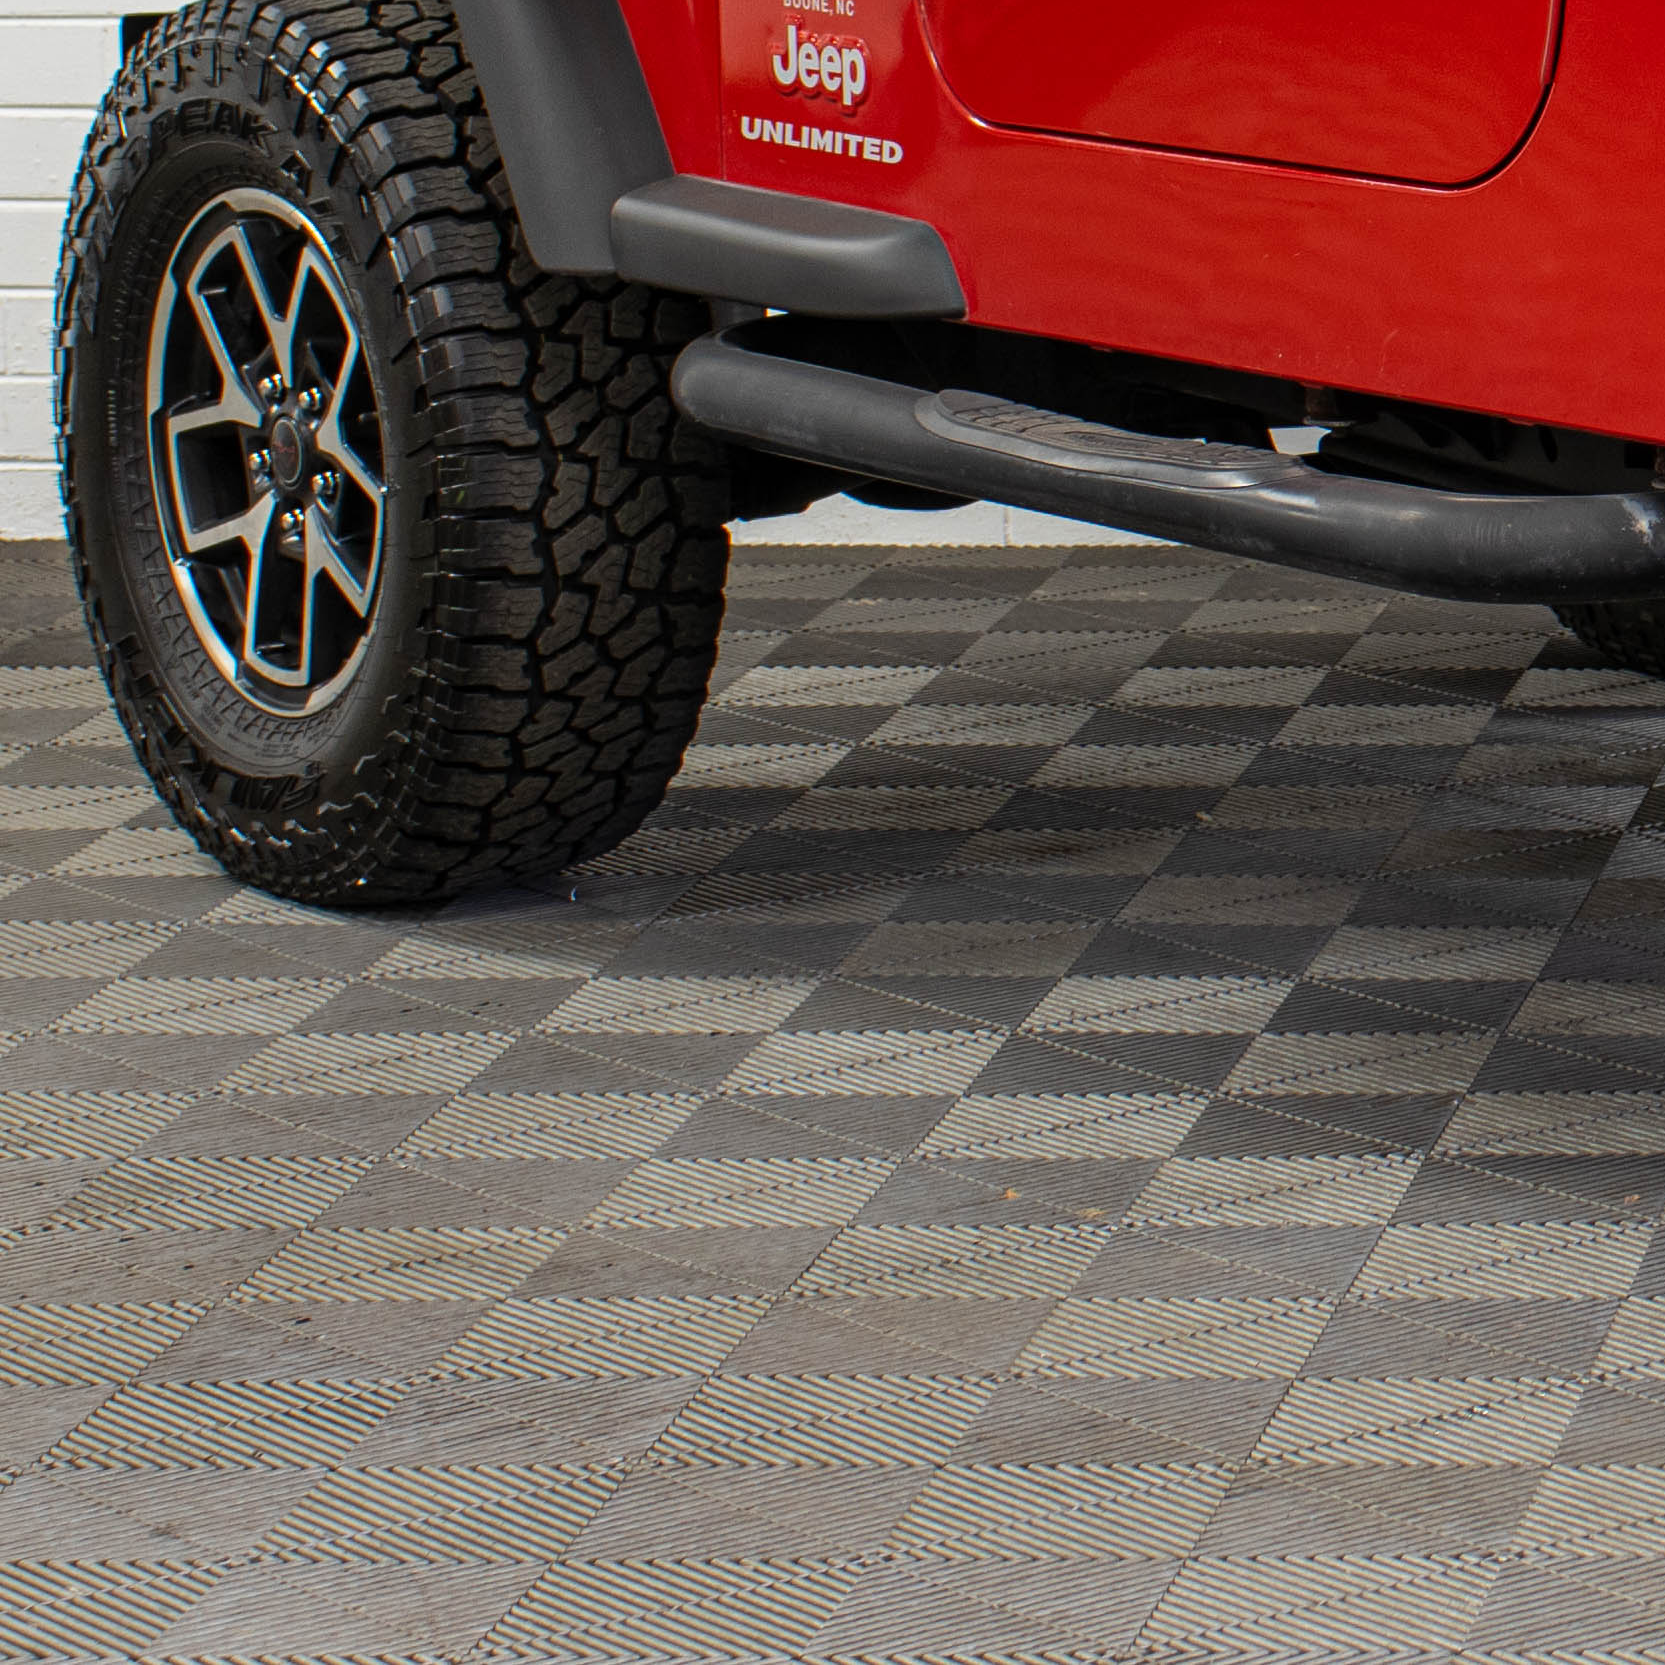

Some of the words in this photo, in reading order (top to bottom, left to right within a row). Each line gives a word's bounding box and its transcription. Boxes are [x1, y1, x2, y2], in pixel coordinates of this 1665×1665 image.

[836, 0, 855, 17] NC
[772, 25, 866, 106] Jeep
[741, 116, 904, 164] UNLIMITED
